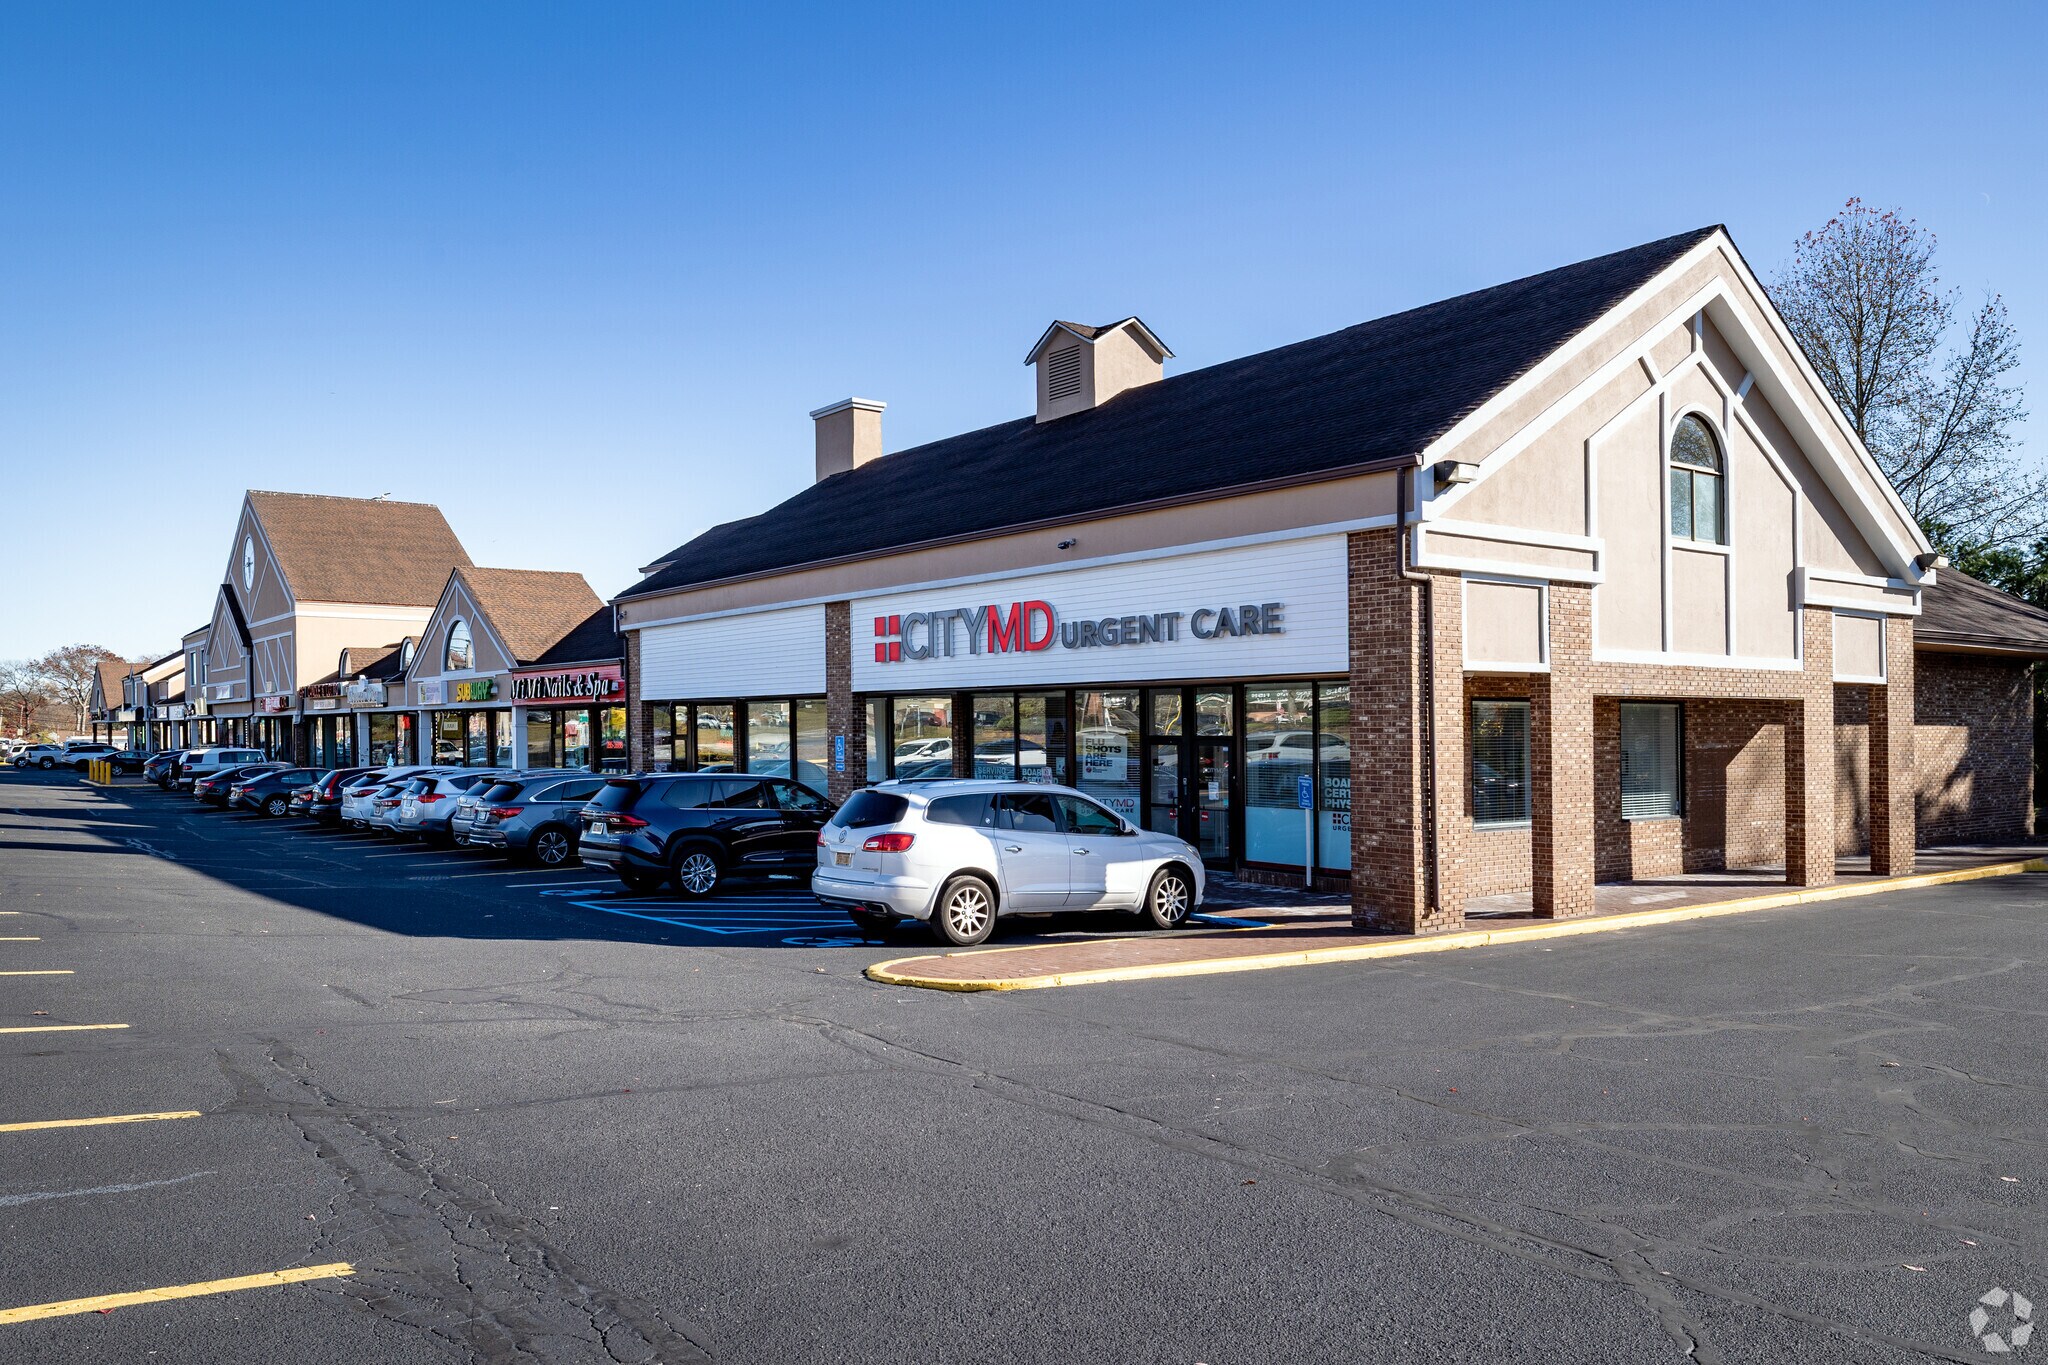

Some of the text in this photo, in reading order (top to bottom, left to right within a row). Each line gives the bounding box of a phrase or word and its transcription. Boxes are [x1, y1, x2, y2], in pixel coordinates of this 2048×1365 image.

[901, 600, 1286, 660] CITYMD URGENT CARE
[456, 679, 494, 702] SUBWAY
[543, 674, 572, 698] Nails
[573, 674, 585, 697] &
[585, 672, 609, 702] Spa
